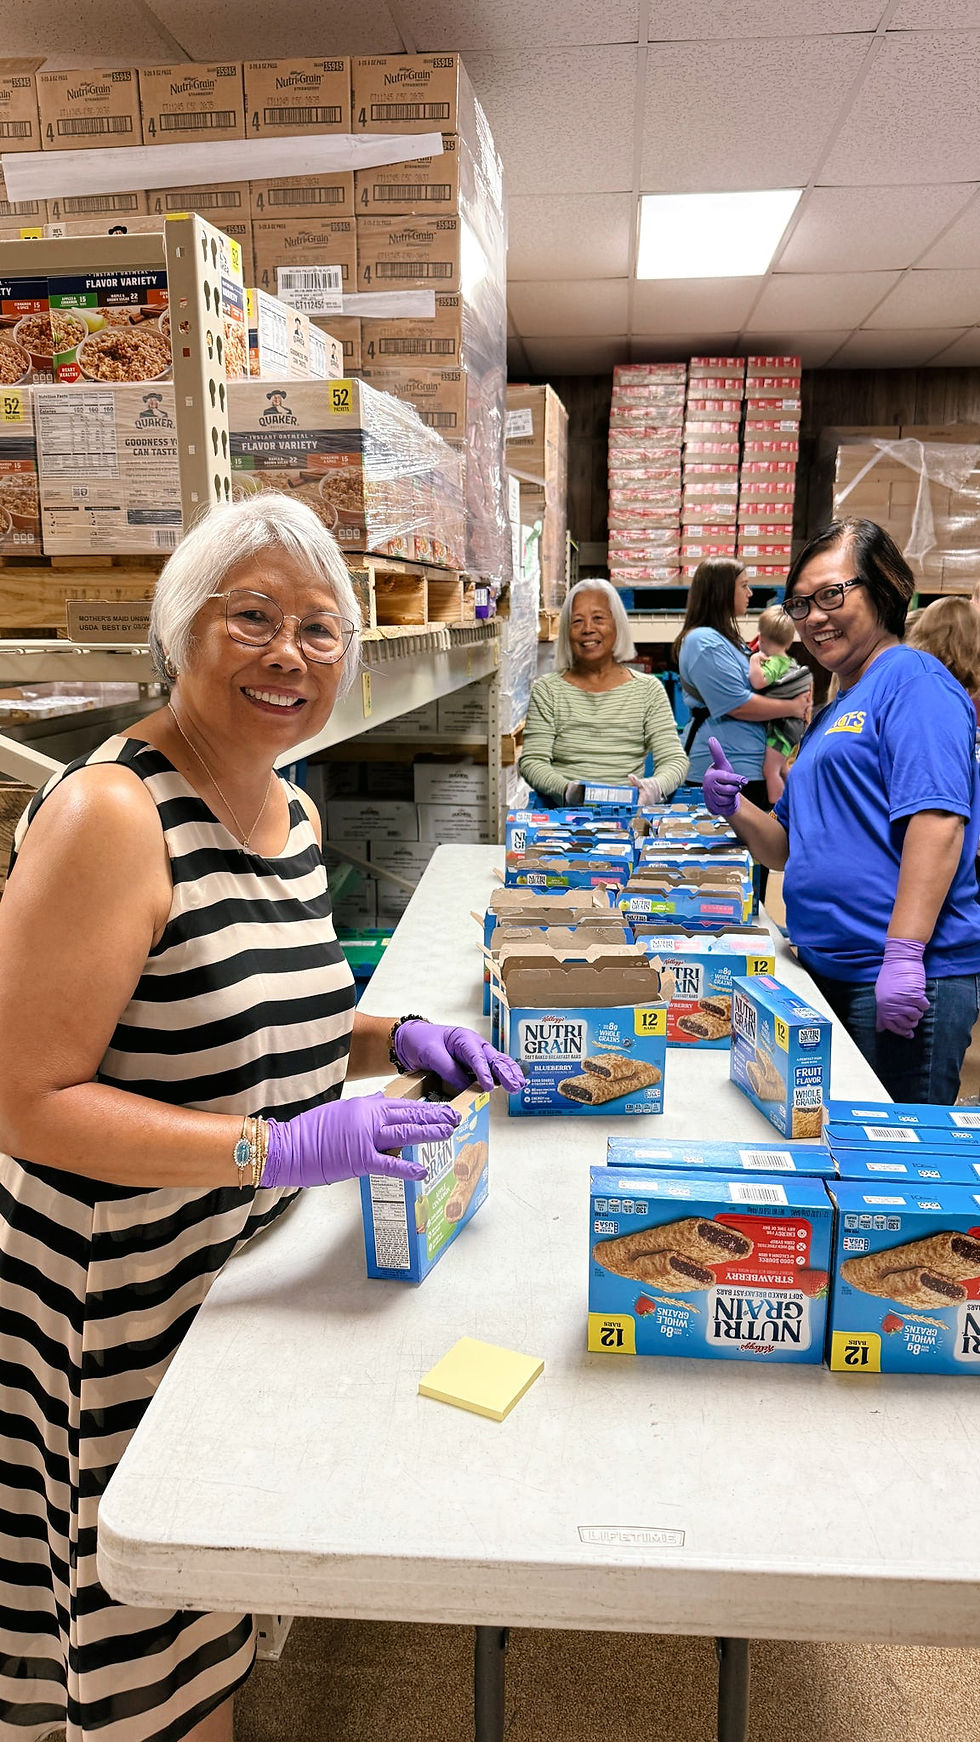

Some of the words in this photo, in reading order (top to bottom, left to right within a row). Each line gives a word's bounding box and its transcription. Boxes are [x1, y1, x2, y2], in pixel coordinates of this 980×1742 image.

[323, 61, 344, 71] 35945
[433, 58, 453, 68] 35945
[112, 71, 131, 82] 35945
[216, 66, 236, 77] 35945
[252, 111, 260, 132] 4
[358, 107, 367, 127] 4
[46, 123, 55, 142] 4
[148, 117, 157, 137] 4
[256, 192, 264, 211] 4
[361, 188, 369, 207] 4
[52, 201, 61, 219] 4
[154, 197, 163, 215] 4
[226, 224, 246, 234] 35945
[331, 222, 350, 232] 35945
[437, 220, 456, 229] 35945
[261, 269, 269, 288] 4
[363, 265, 372, 284] 4
[86, 278, 118, 289] FLAVOR
[120, 276, 157, 286] VARIETY
[439, 297, 459, 306] 35945
[366, 341, 375, 359] 4
[333, 389, 349, 407] 52
[4, 398, 20, 415] 52
[135, 418, 173, 430] QUAKER
[258, 416, 297, 427] QUAKER
[125, 438, 168, 447] GOODNESS
[242, 441, 275, 451] FLAVOR
[280, 440, 318, 450] VARIETY
[133, 448, 149, 456] CAN
[152, 448, 177, 456] TASTE
[663, 958, 684, 966] Kellogg's
[754, 960, 768, 972] 12
[722, 967, 731, 975] 8g
[735, 995, 756, 1024] NUTRI
[542, 1015, 566, 1023] Kellogg's
[641, 1013, 657, 1026] 12
[609, 1022, 618, 1031] 8g
[735, 1011, 756, 1040] GRAIN
[777, 1022, 785, 1040] 12
[525, 1024, 582, 1042] NUTRI
[525, 1038, 582, 1054] GRAIN
[796, 1066, 822, 1077] FRUIT
[796, 1077, 822, 1085] FLAVOR
[795, 1088, 821, 1099] WHOLE
[795, 1096, 821, 1106] GRAINS
[423, 1145, 453, 1186] GRAIN
[848, 1237, 864, 1245] USA
[725, 1272, 794, 1284] STRAWBERRY
[716, 1288, 732, 1296] BARS
[733, 1289, 766, 1299] BREAKFAST
[768, 1291, 787, 1300] BAKED
[788, 1292, 803, 1300] SOFT
[657, 1307, 690, 1319] GRAINS
[714, 1297, 804, 1321] GRAIN
[656, 1316, 688, 1328] WHOLE
[660, 1324, 673, 1338] 8g
[714, 1319, 801, 1343] NUTRI
[904, 1324, 938, 1336] GRAINS
[600, 1327, 624, 1347] 12
[903, 1332, 936, 1345] WHOLE
[740, 1344, 775, 1355] Kellogg's
[906, 1341, 921, 1355] 8g
[844, 1345, 869, 1365] 12
[588, 1531, 677, 1544] LIFETIME
